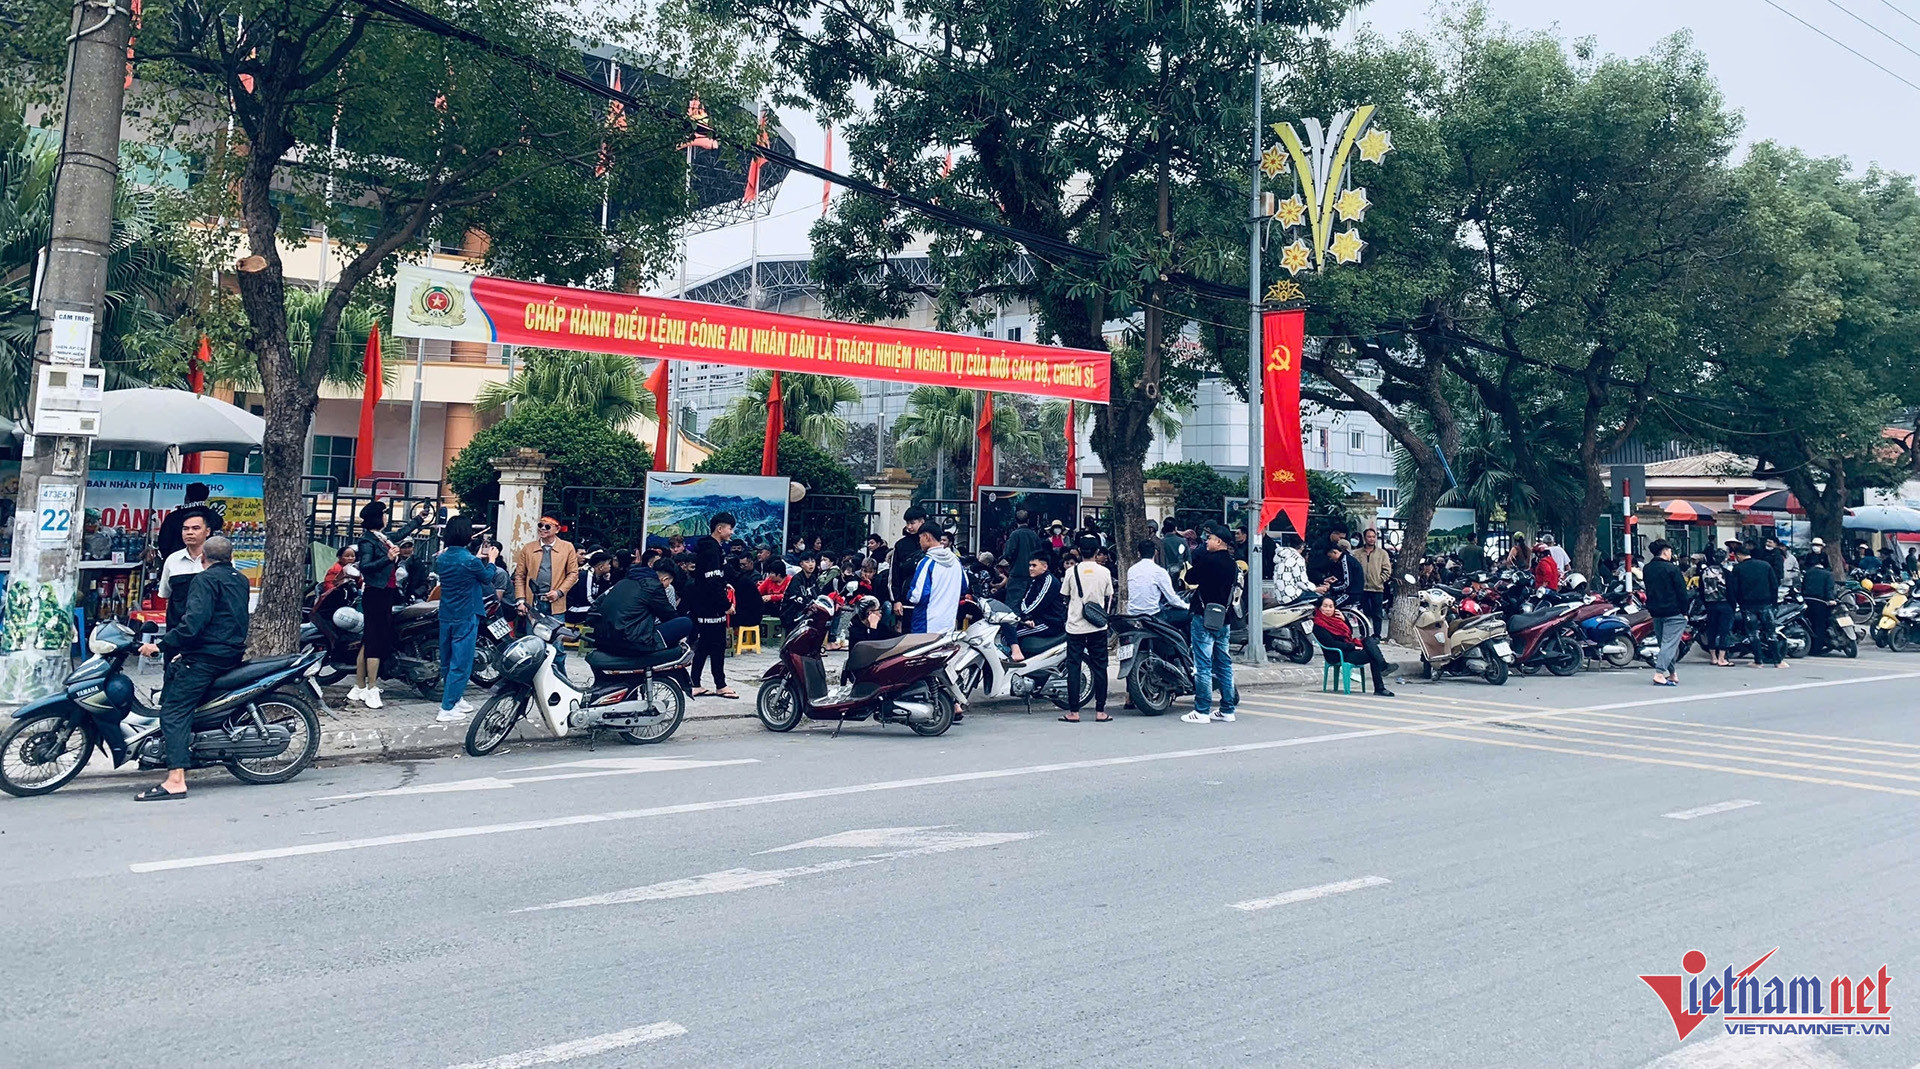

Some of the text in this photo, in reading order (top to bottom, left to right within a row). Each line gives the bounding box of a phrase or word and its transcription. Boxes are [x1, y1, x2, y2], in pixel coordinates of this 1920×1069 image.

[524, 296, 567, 333] CHẤP
[569, 303, 611, 338] HÀNH
[613, 306, 648, 341] ĐIỀU
[650, 312, 686, 349] LỆNH
[689, 317, 726, 350] CÔNG
[728, 326, 748, 352] AN
[750, 325, 787, 356] NHÂN
[789, 329, 816, 359] DÂN
[817, 332, 832, 361] LÀ
[836, 335, 873, 365] TRÁCH
[875, 340, 912, 373] NHIỆM
[914, 345, 947, 373] NGHĨA
[950, 350, 964, 379] VỤ
[966, 347, 987, 377] CỦA
[1034, 358, 1051, 388] BỘ,
[1053, 358, 1082, 387] CHIẾN
[62, 447, 70, 465] 7
[86, 480, 107, 488] BAN
[110, 479, 137, 490] NHÂN
[162, 480, 183, 491] TỈNH
[40, 508, 71, 531] 22
[101, 503, 151, 534] OÀN
[76, 685, 99, 697] YAMAHA
